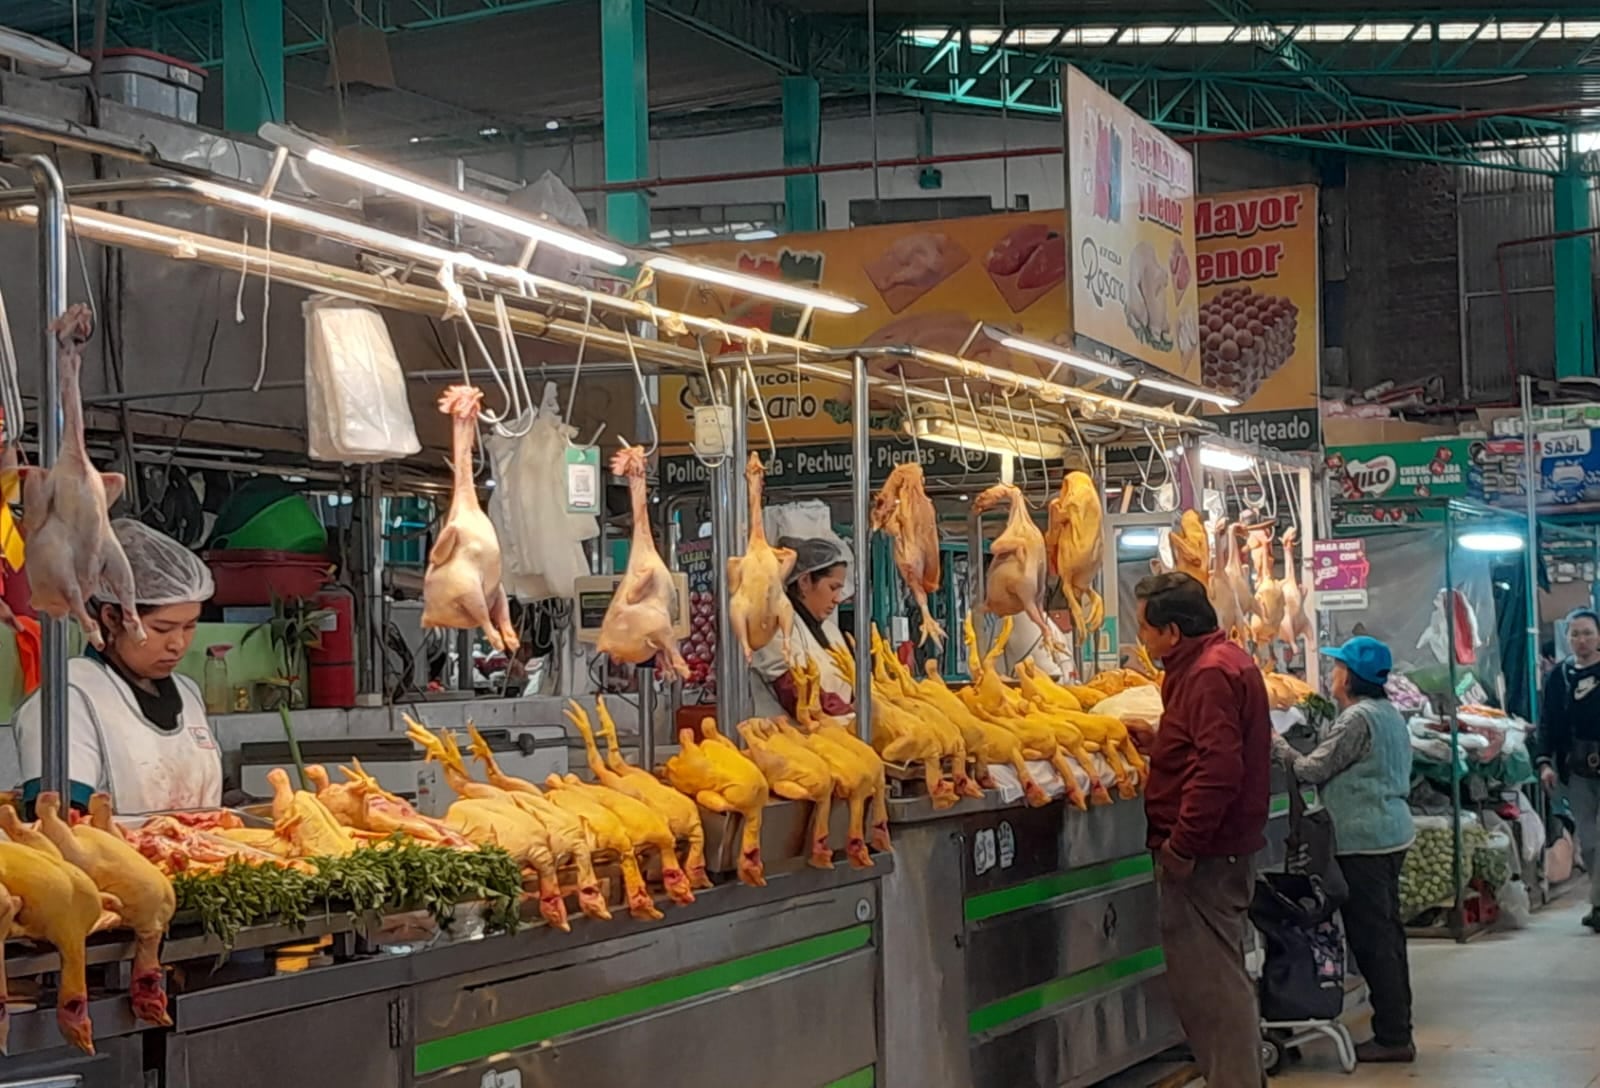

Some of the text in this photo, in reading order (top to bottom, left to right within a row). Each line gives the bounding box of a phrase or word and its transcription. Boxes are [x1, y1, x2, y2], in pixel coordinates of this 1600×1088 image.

[1147, 182, 1183, 233] Menor
[1197, 243, 1281, 282] enor
[1230, 415, 1310, 440] Fileteado
[797, 449, 855, 476] Pechug
[877, 445, 935, 468] Piernas
[950, 447, 983, 463] Aas
